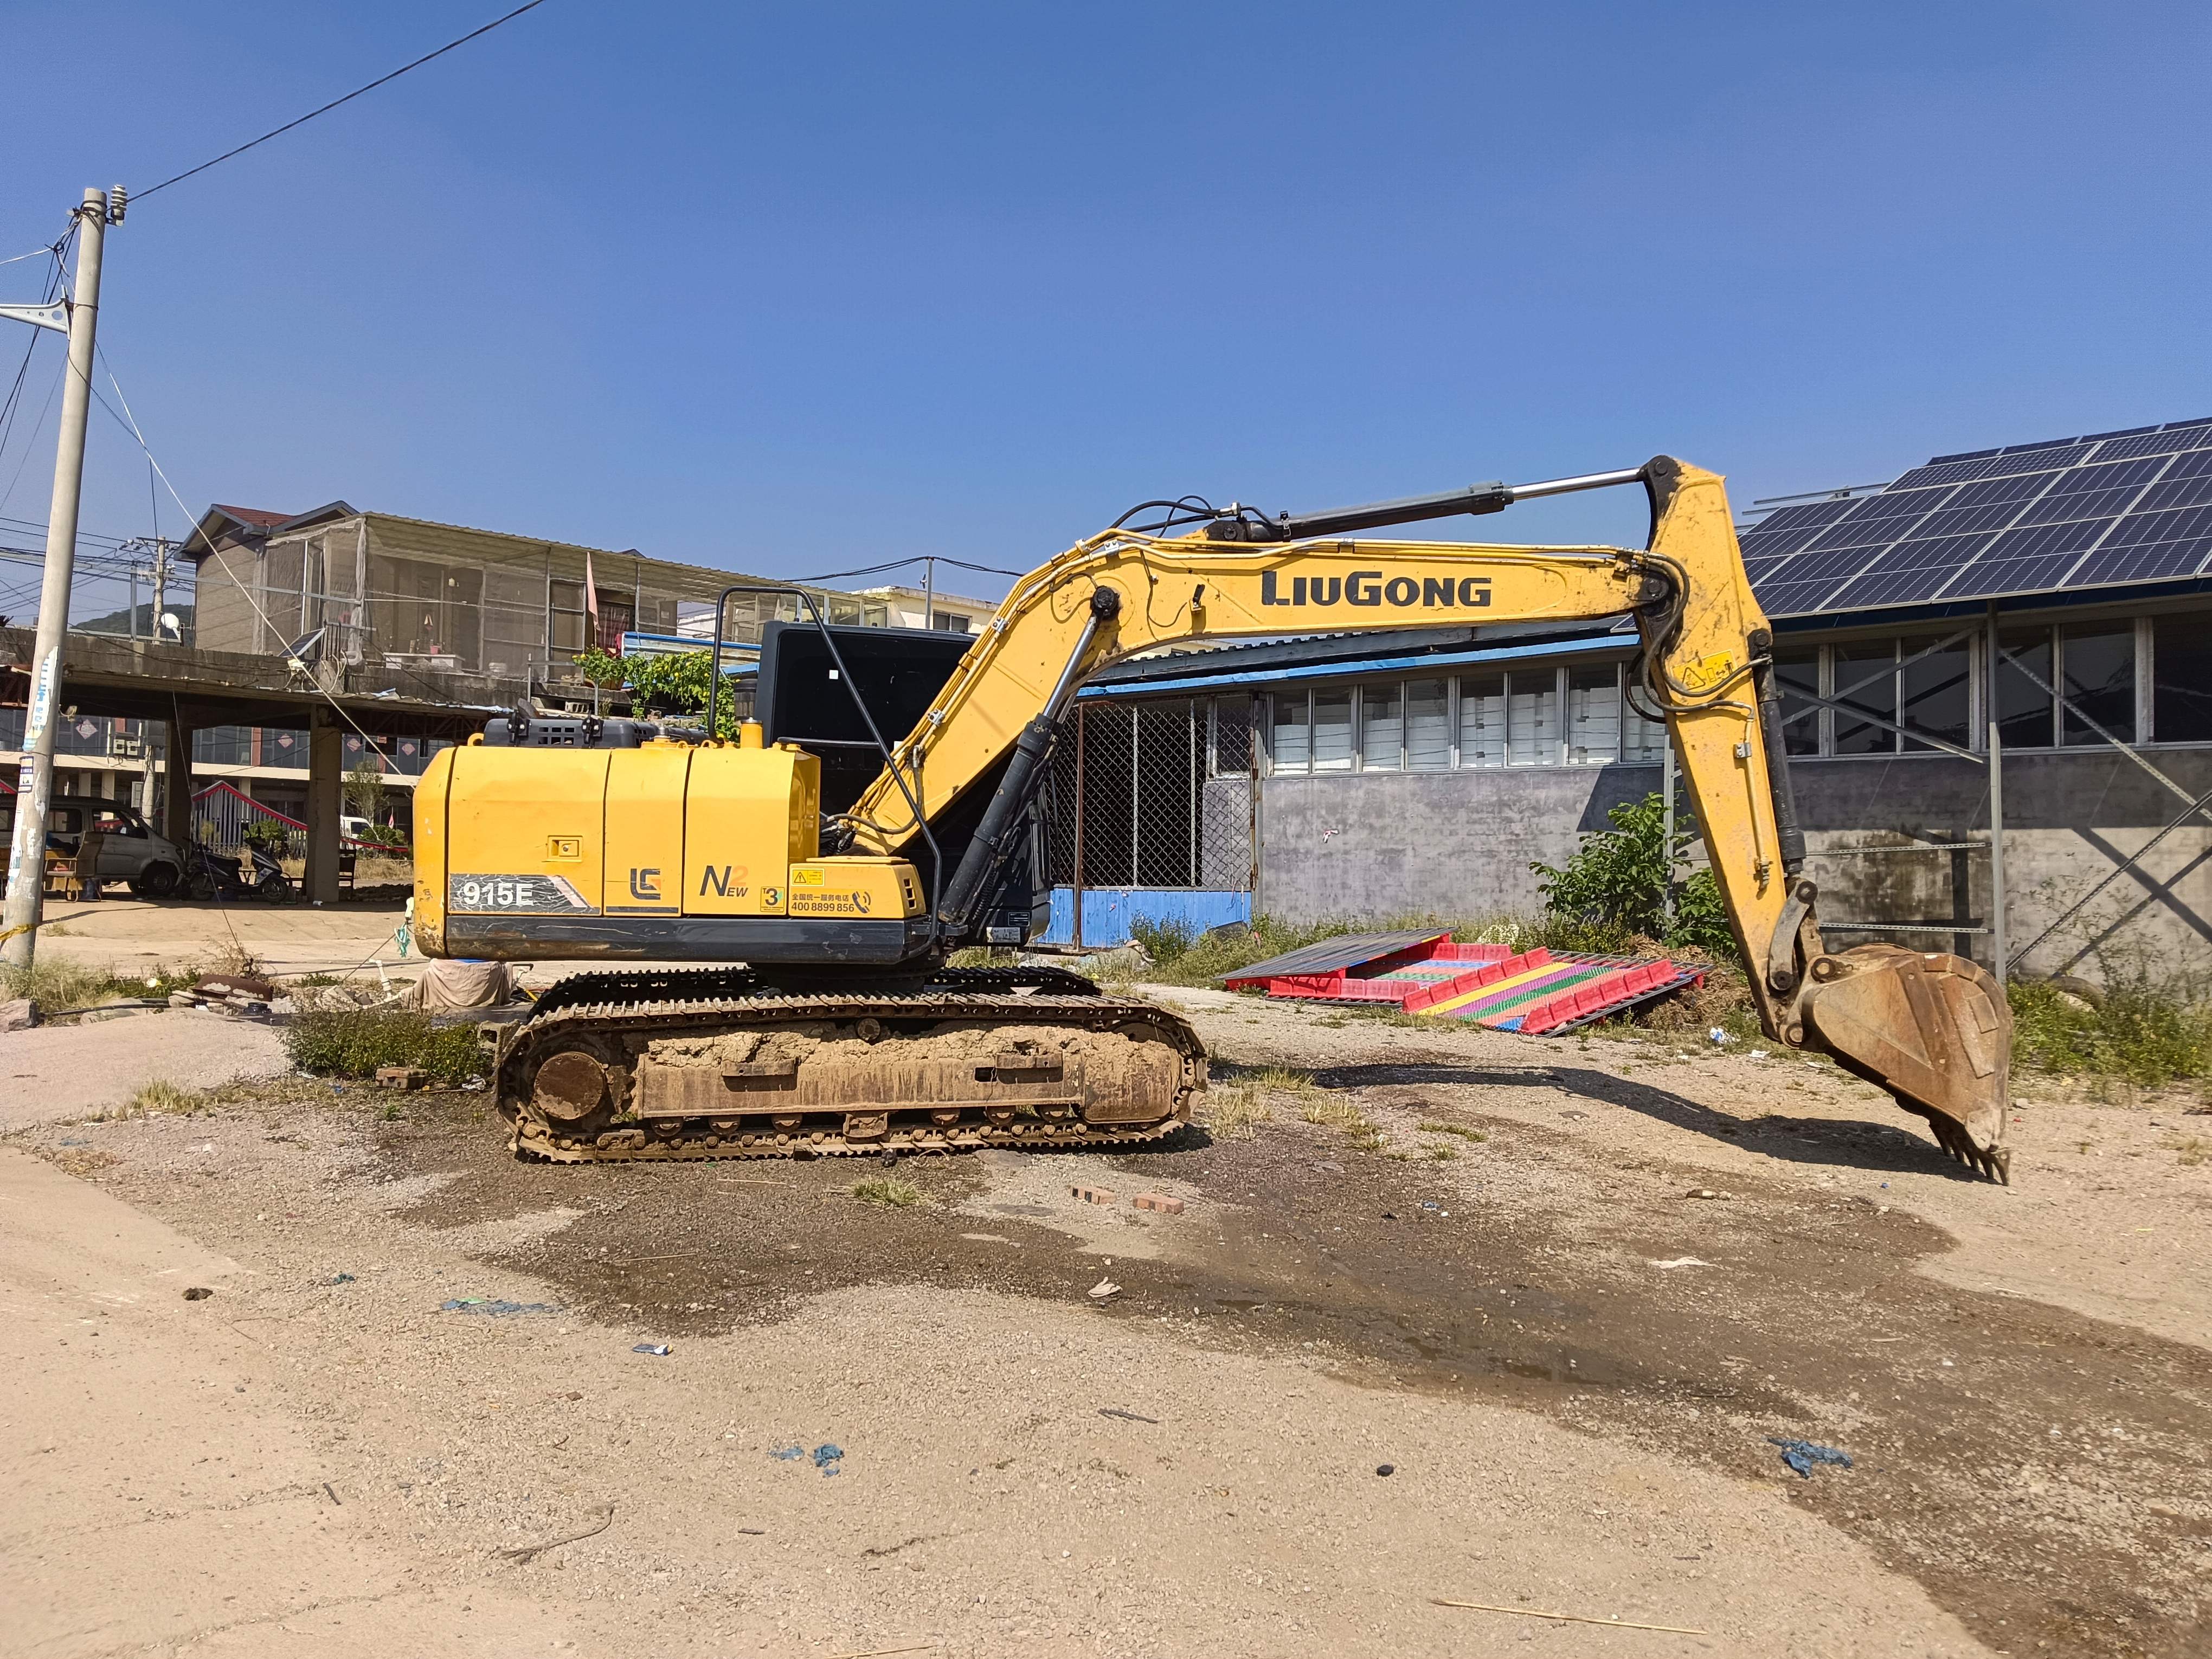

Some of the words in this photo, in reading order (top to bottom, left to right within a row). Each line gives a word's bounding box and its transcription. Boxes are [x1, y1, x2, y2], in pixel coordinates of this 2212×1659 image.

[463, 882, 533, 906] 915E
[792, 893, 849, 902] 全国统一服务电话
[792, 902, 809, 911] 400
[811, 903, 835, 911] 8899
[837, 904, 854, 912] 856
